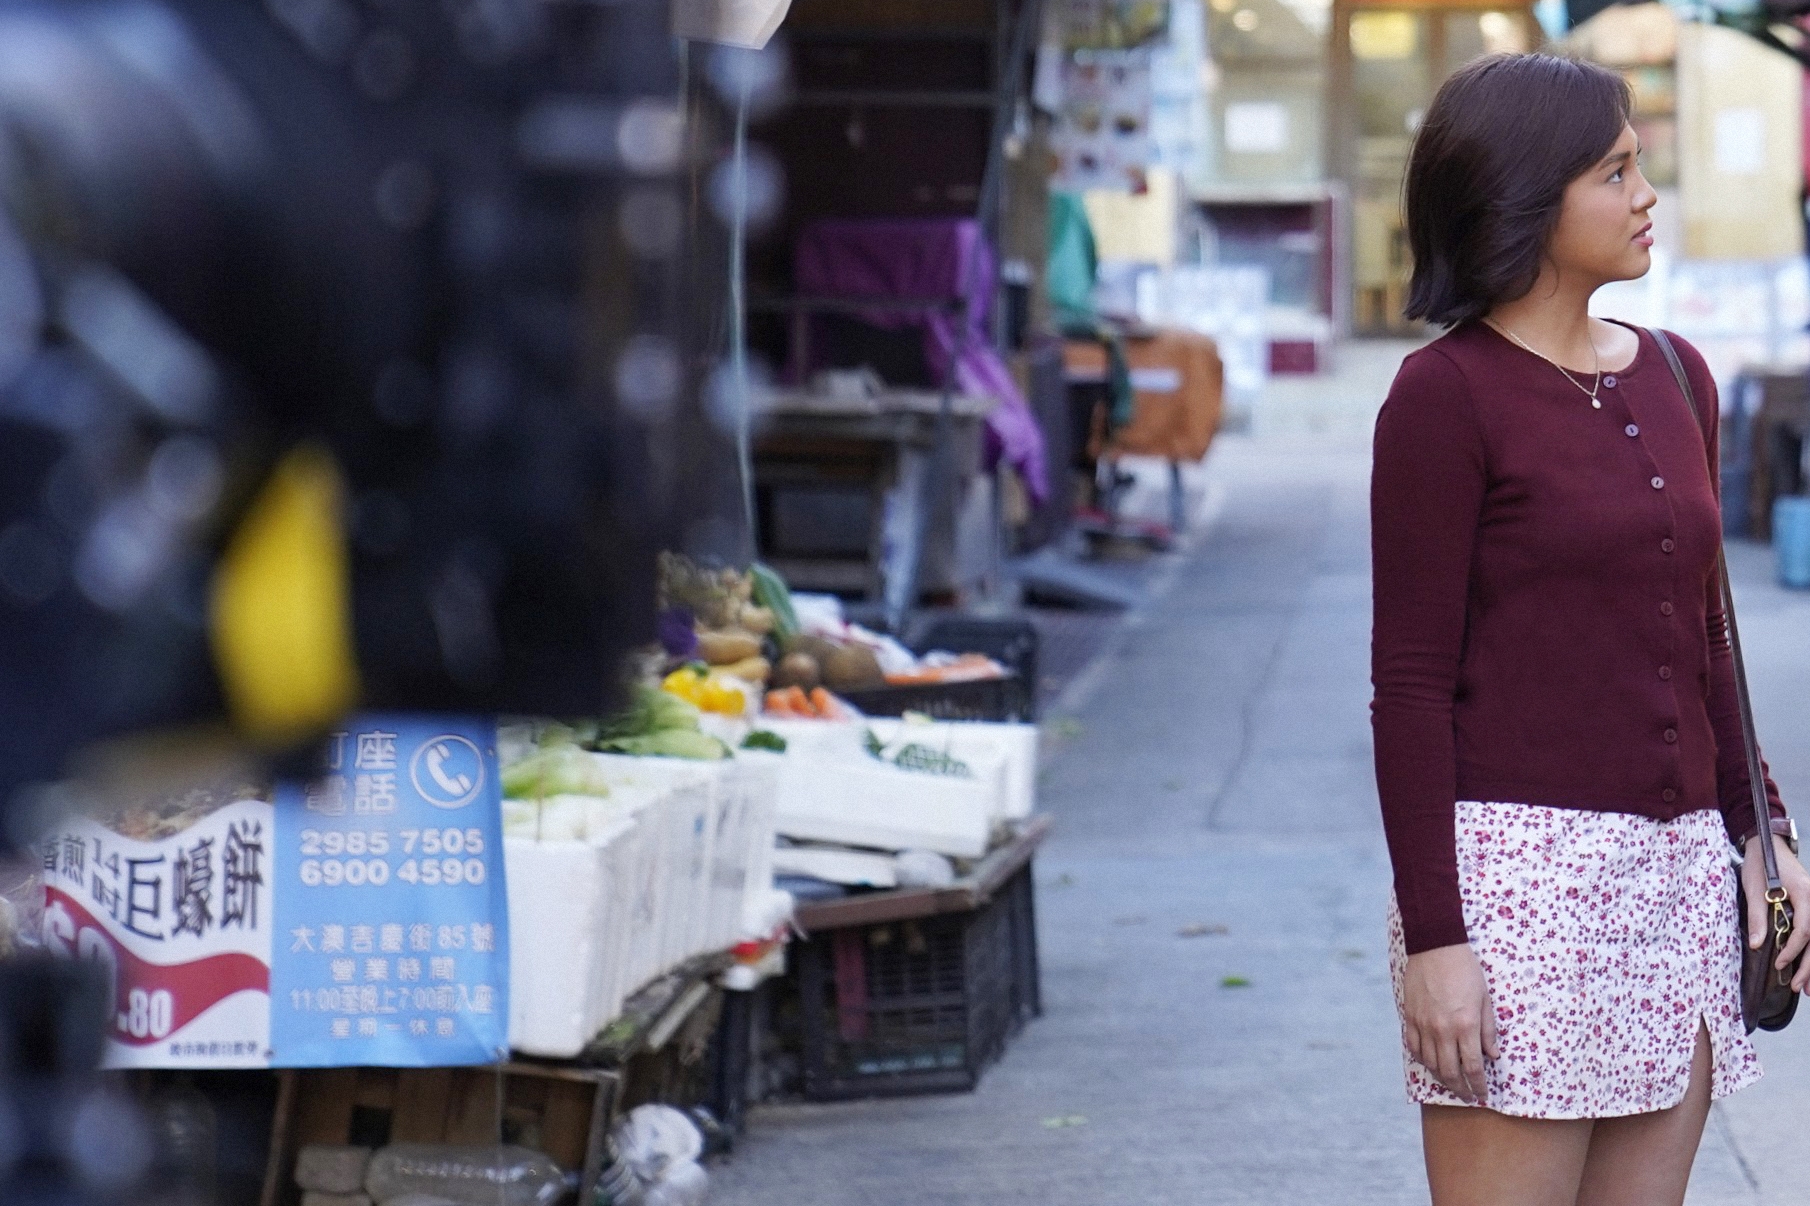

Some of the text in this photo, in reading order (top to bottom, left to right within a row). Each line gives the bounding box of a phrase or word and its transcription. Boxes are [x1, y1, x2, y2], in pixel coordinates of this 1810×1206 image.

[305, 773, 397, 816] 電話
[301, 827, 486, 856] 2985 7505
[300, 857, 486, 887] 6900 4590
[330, 956, 456, 982] 營業時間
[330, 1017, 455, 1039] 星期一休息
